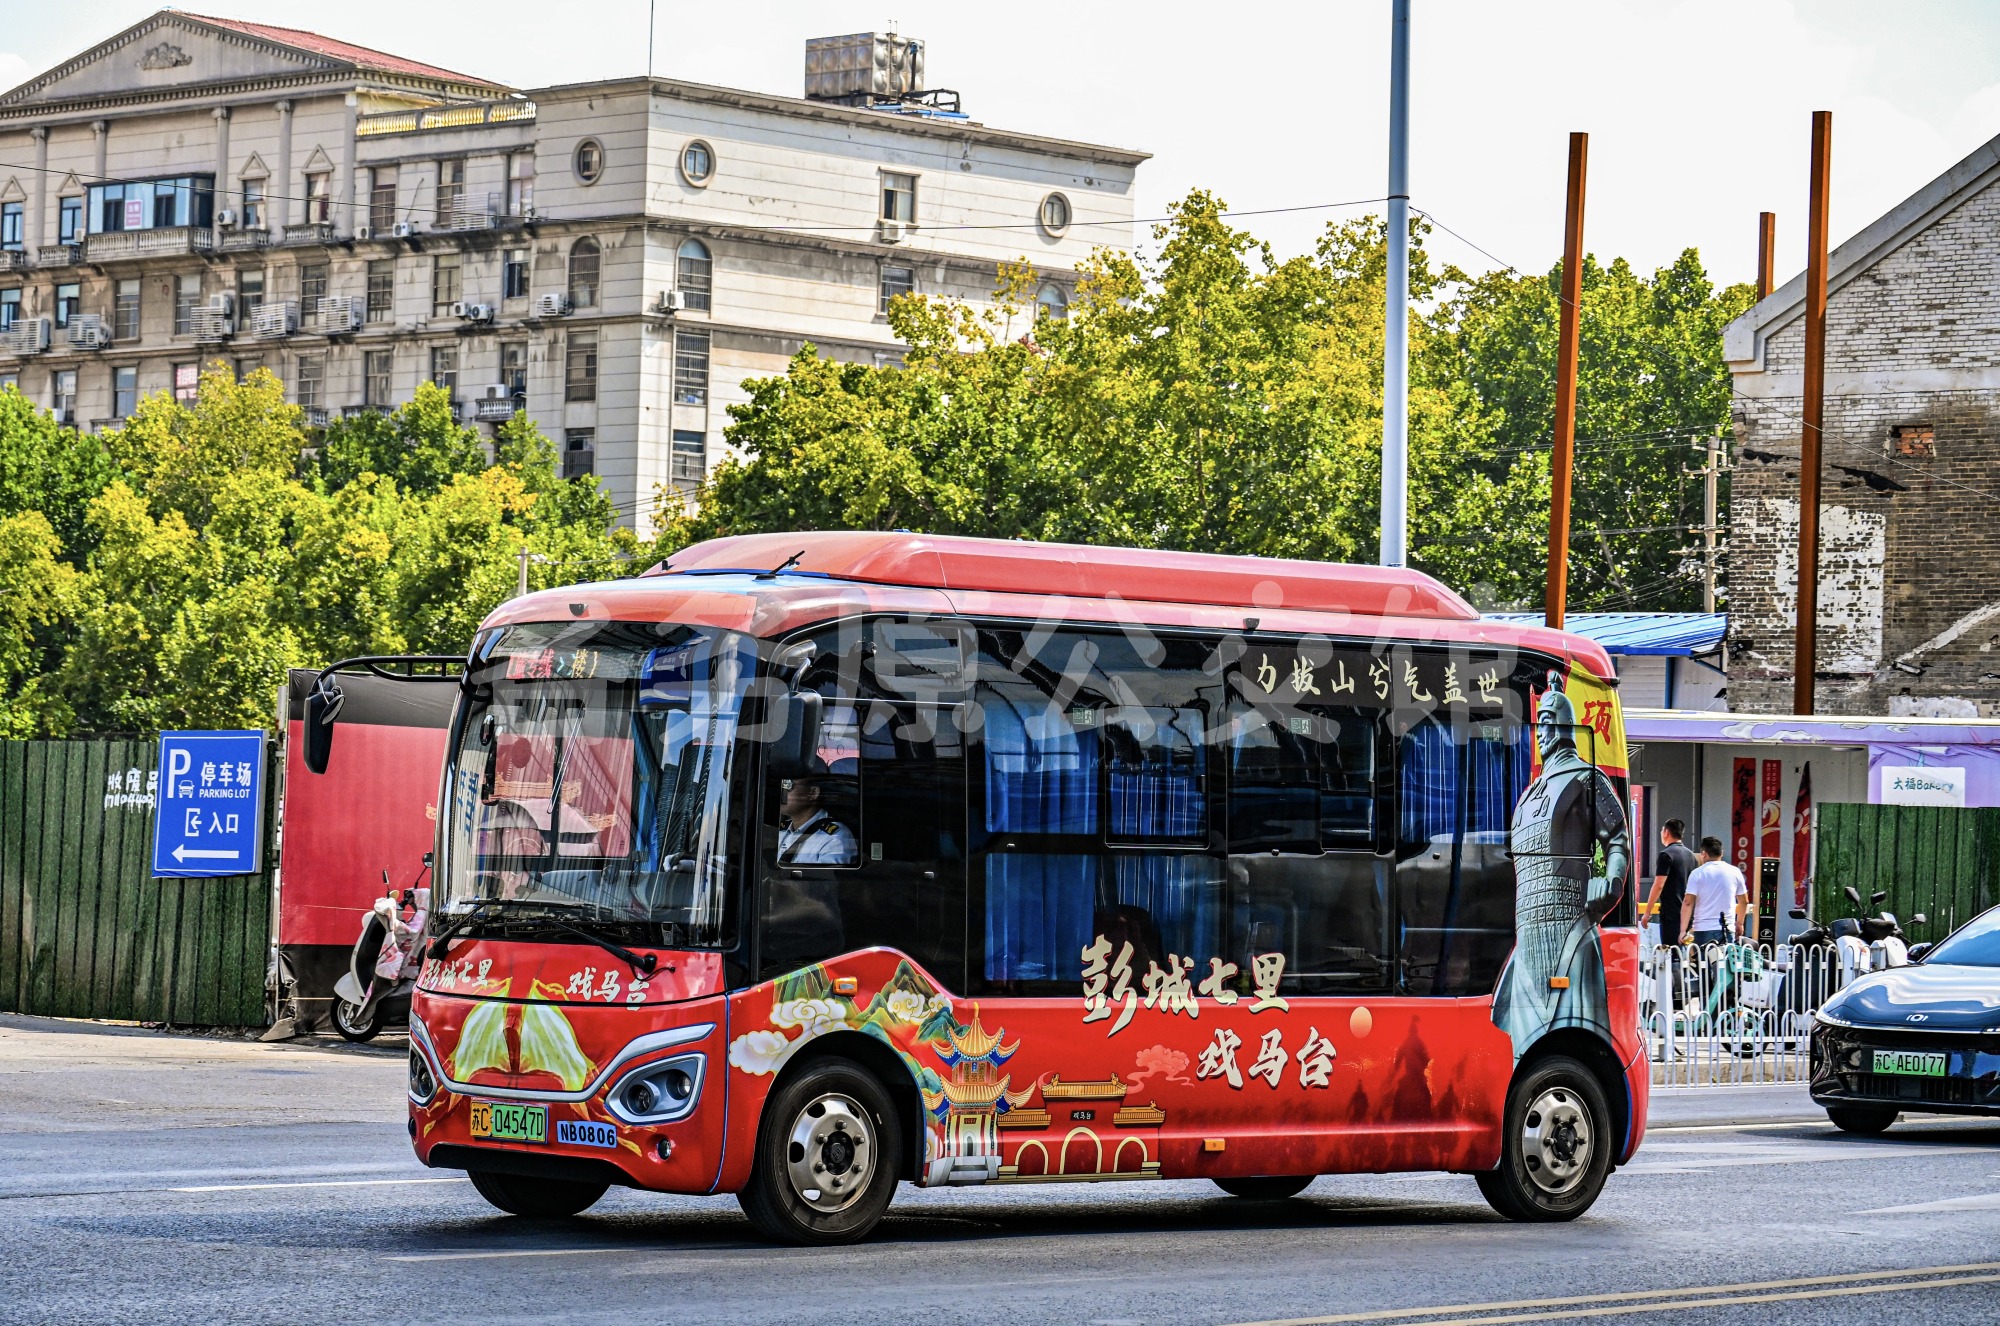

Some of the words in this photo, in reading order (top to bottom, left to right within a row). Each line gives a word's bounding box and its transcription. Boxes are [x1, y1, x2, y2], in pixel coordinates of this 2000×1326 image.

[1257, 653, 1503, 705] 力拔山兮气盖世
[1581, 700, 1613, 745] 项
[107, 767, 159, 793] 收废品
[167, 748, 192, 798] P
[199, 788, 234, 798] PARKING
[234, 788, 251, 798] LOT
[200, 761, 252, 787] 停车场
[208, 811, 239, 834] 入口
[424, 958, 493, 993] 彭城七里
[566, 966, 650, 1011] 戏马台
[1081, 934, 1290, 1038] 彭城七里
[1196, 1026, 1337, 1091] 戏马台
[560, 1123, 615, 1146] NB0806
